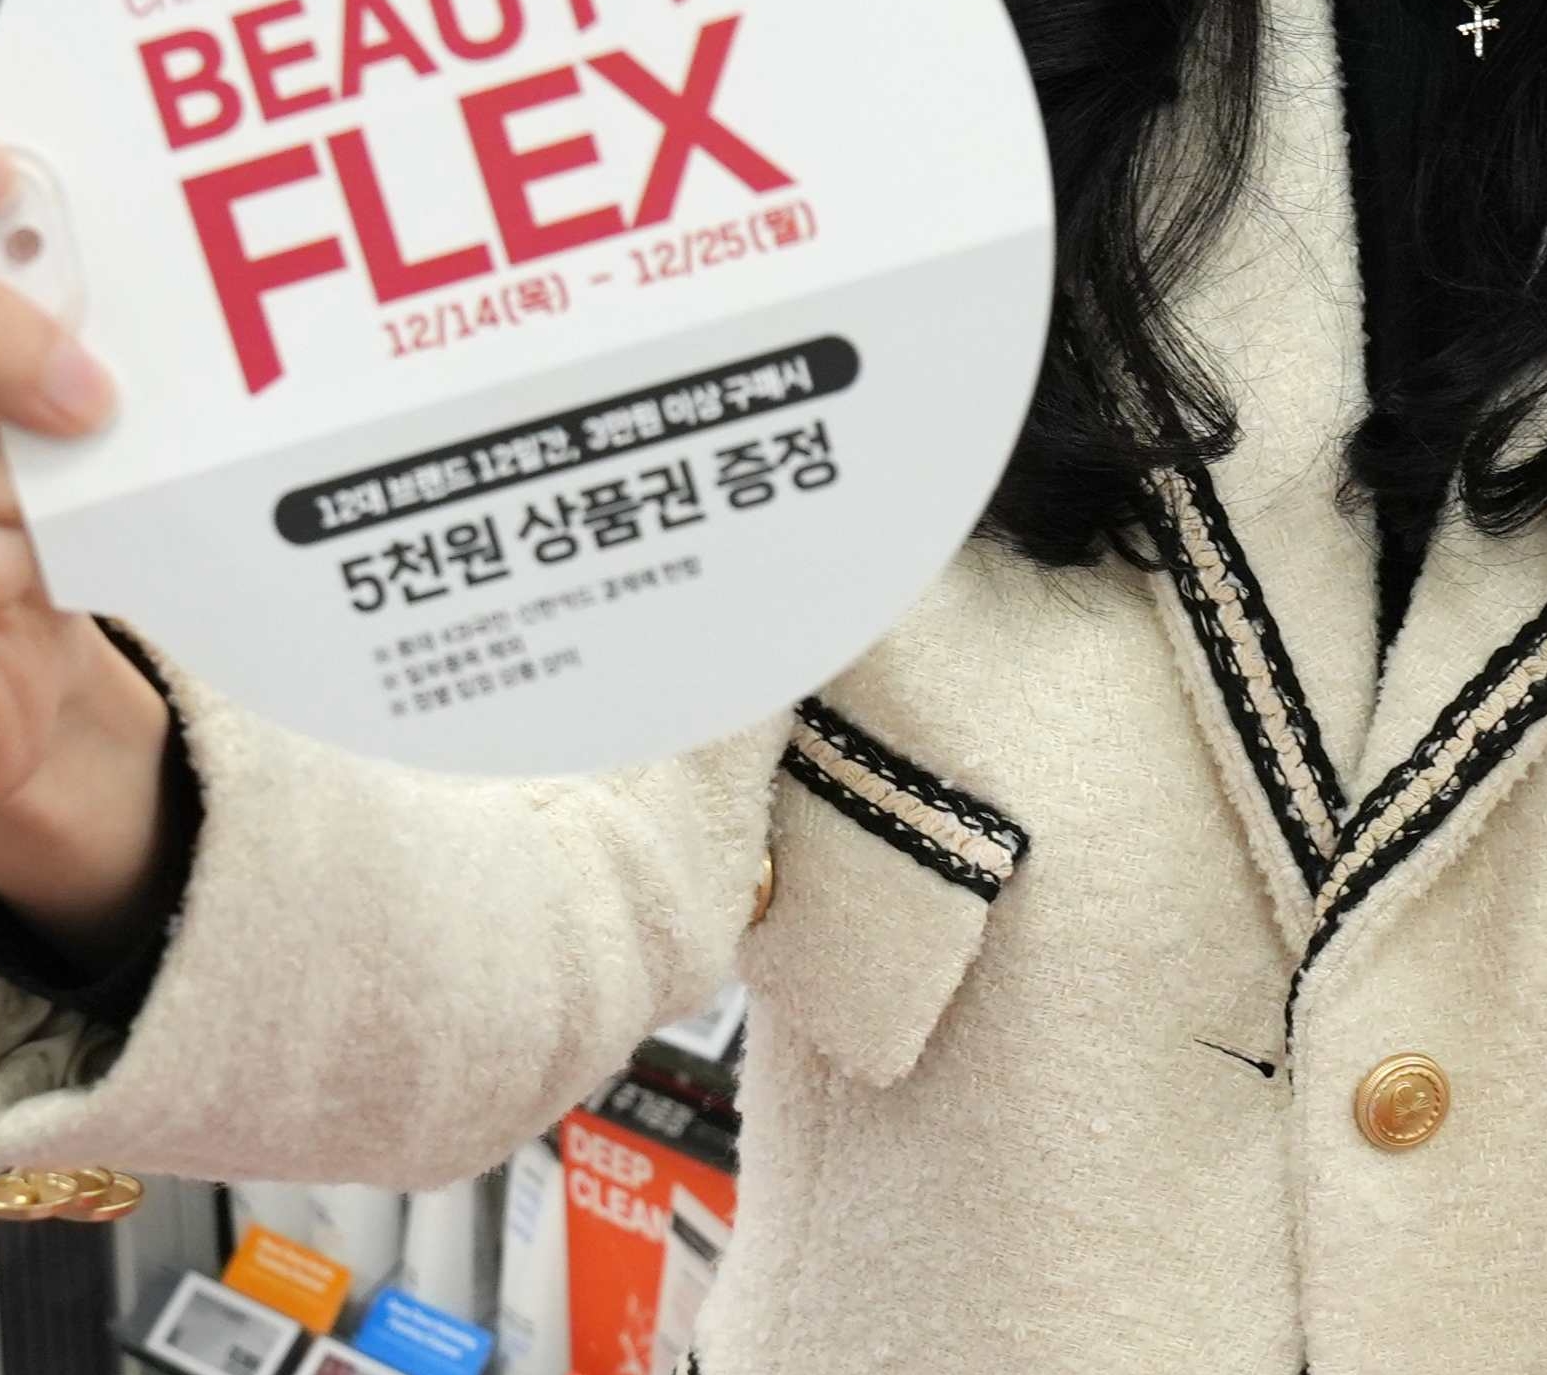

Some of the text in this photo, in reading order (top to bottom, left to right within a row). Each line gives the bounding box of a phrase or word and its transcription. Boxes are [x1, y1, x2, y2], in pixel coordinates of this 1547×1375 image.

[179, 11, 800, 397] FLEX
[381, 273, 572, 360] 12/14(목)
[340, 520, 513, 615] 5천원
[516, 457, 706, 569] 상품권
[714, 421, 841, 510] 증정
[564, 1123, 654, 1186] DEEP
